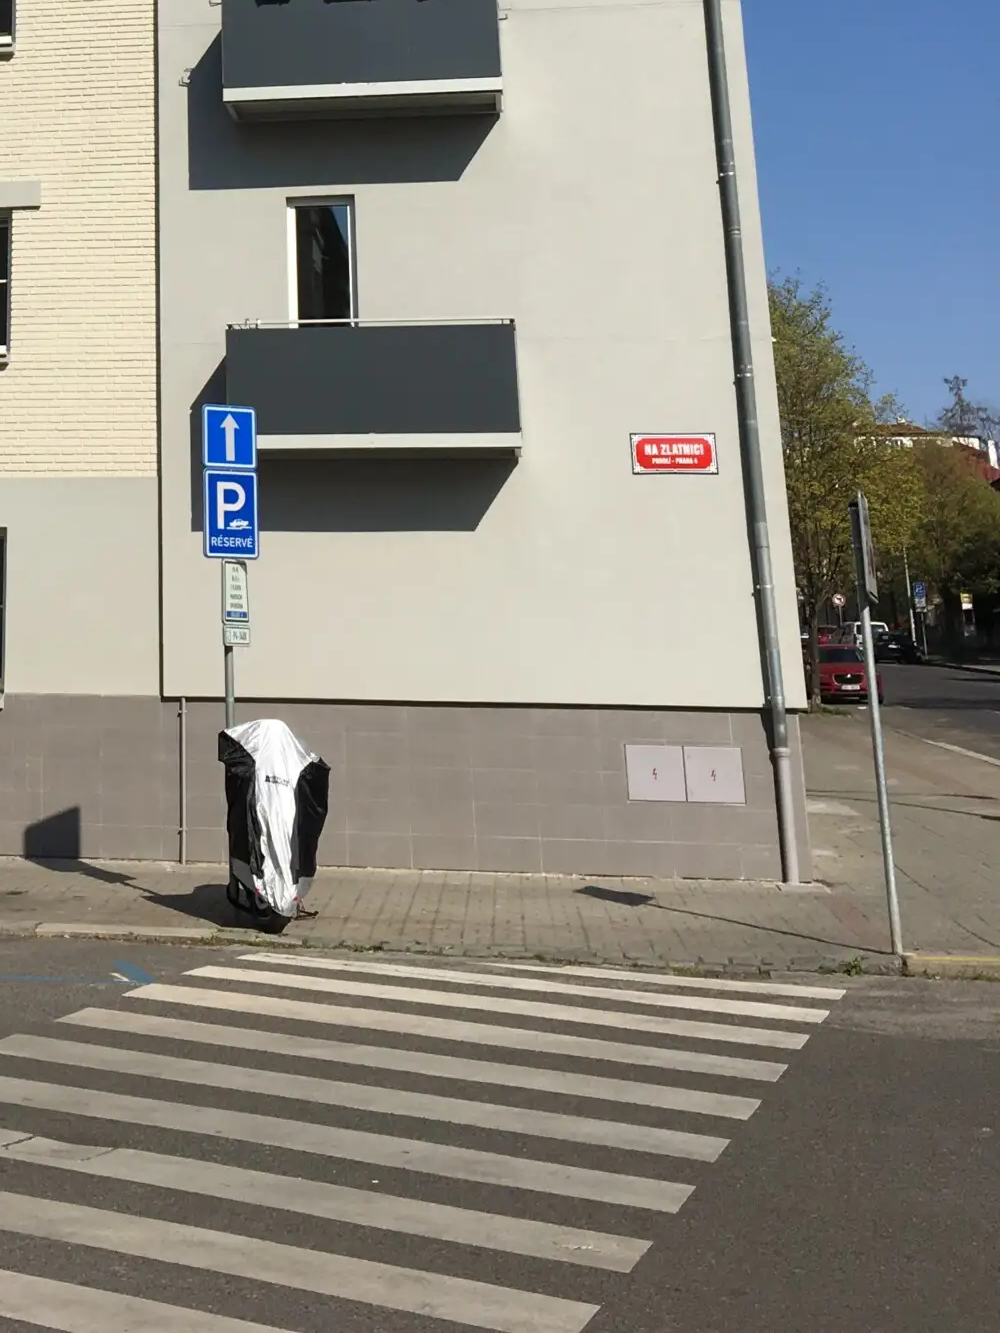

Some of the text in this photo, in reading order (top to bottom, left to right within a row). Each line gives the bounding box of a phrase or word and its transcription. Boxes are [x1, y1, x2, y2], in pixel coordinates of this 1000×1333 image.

[644, 443, 705, 456] NA ZLATNICI
[216, 481, 246, 530] P
[211, 534, 253, 548] RÉSERVÉ
